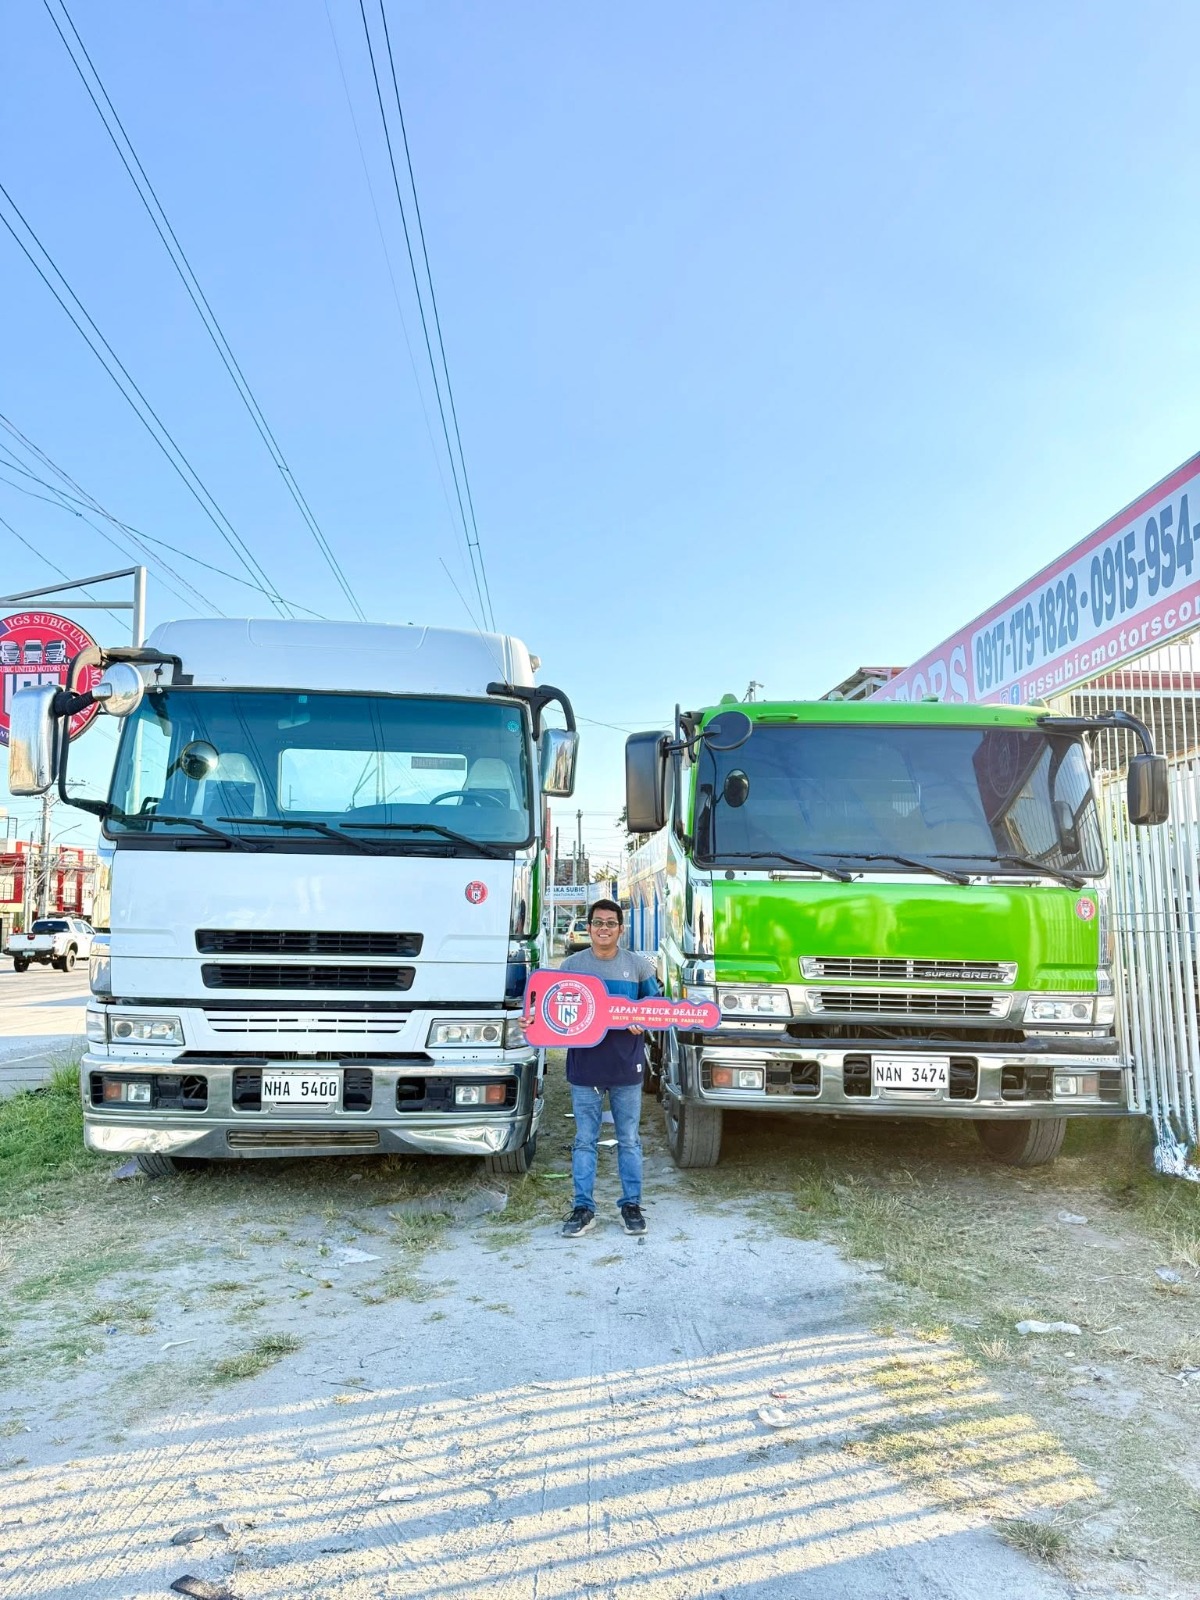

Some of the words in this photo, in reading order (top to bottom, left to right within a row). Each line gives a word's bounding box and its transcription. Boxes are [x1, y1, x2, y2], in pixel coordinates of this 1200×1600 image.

[8, 615, 30, 627] IGS
[33, 615, 71, 631] SUBIC
[976, 572, 1080, 693] 0917-179-1828
[961, 971, 1009, 980] GREAT
[609, 1005, 638, 1014] JAPAN
[640, 1007, 671, 1015] TRUCK
[673, 1008, 709, 1017] DEALER
[876, 1066, 902, 1082] NAN
[912, 1067, 946, 1083] 3474
[264, 1081, 290, 1096] NHA
[301, 1081, 337, 1096] 5400
